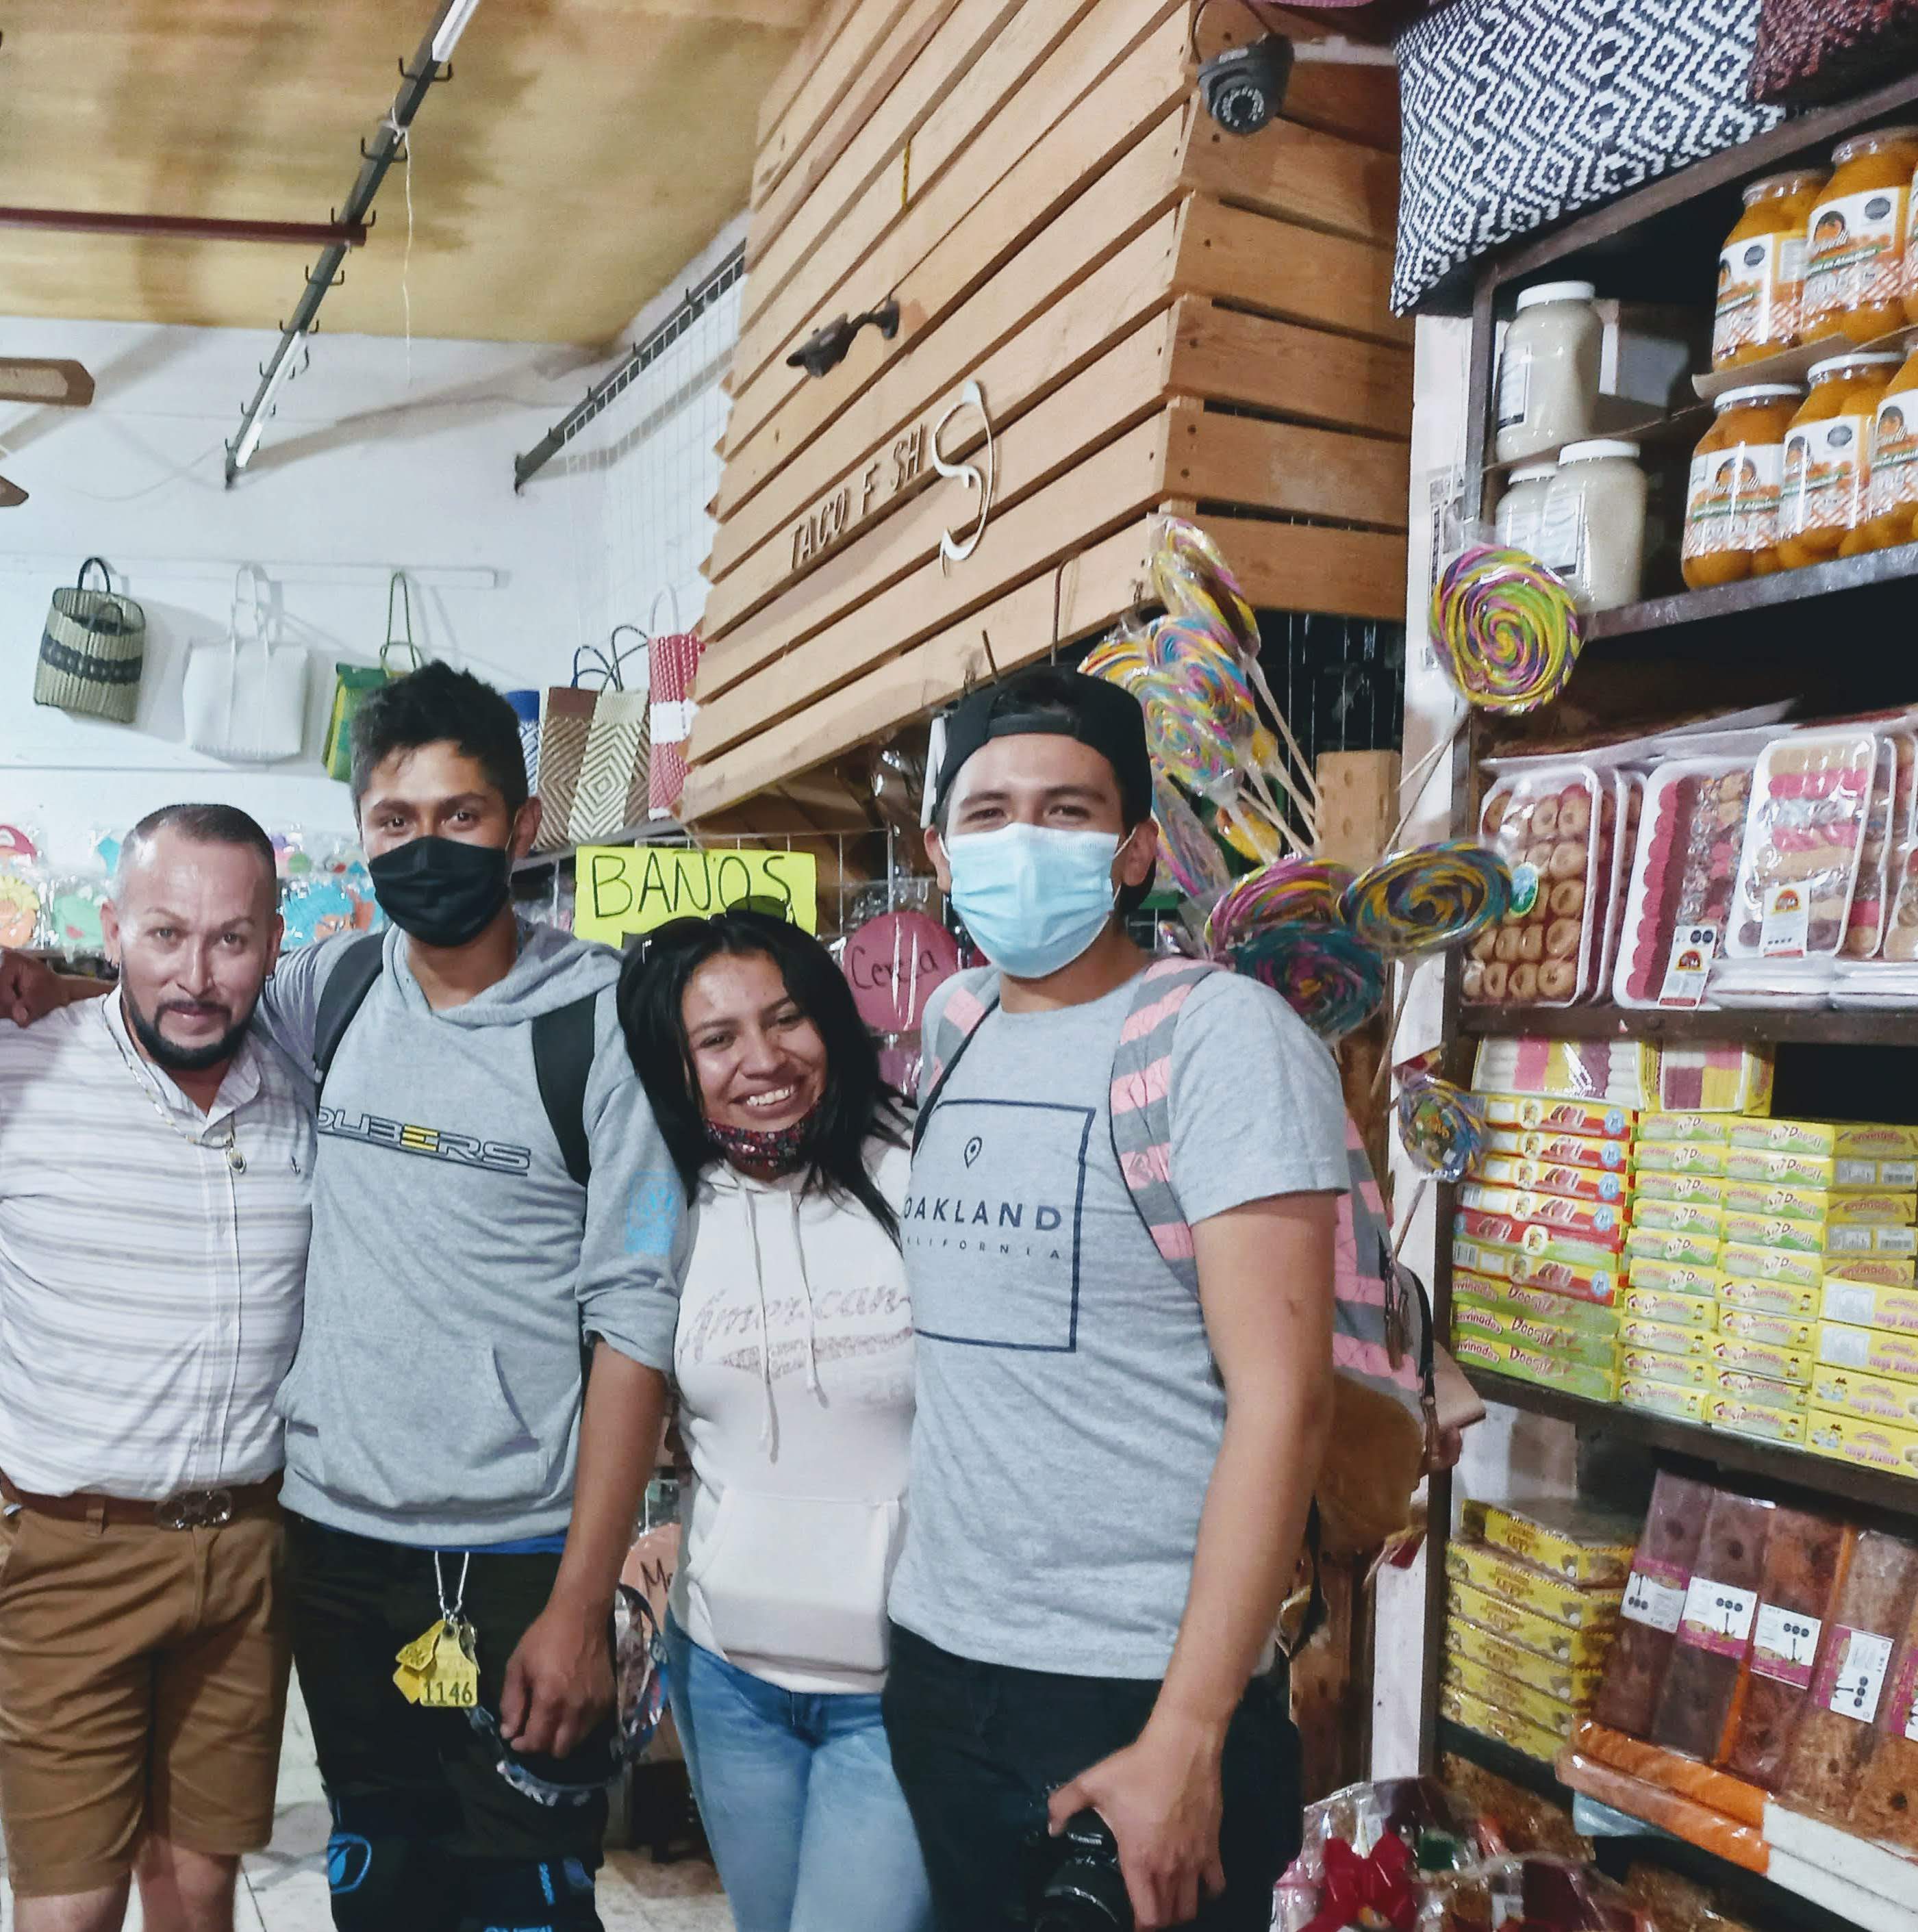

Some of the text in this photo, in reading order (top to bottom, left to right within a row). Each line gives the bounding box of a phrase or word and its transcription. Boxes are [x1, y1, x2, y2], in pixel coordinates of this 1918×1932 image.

[790, 487, 848, 570] TACO
[903, 1195, 1062, 1232] OAKLAND
[907, 1237, 1060, 1260] LIFORNIA
[422, 1680, 473, 1706] 1146
